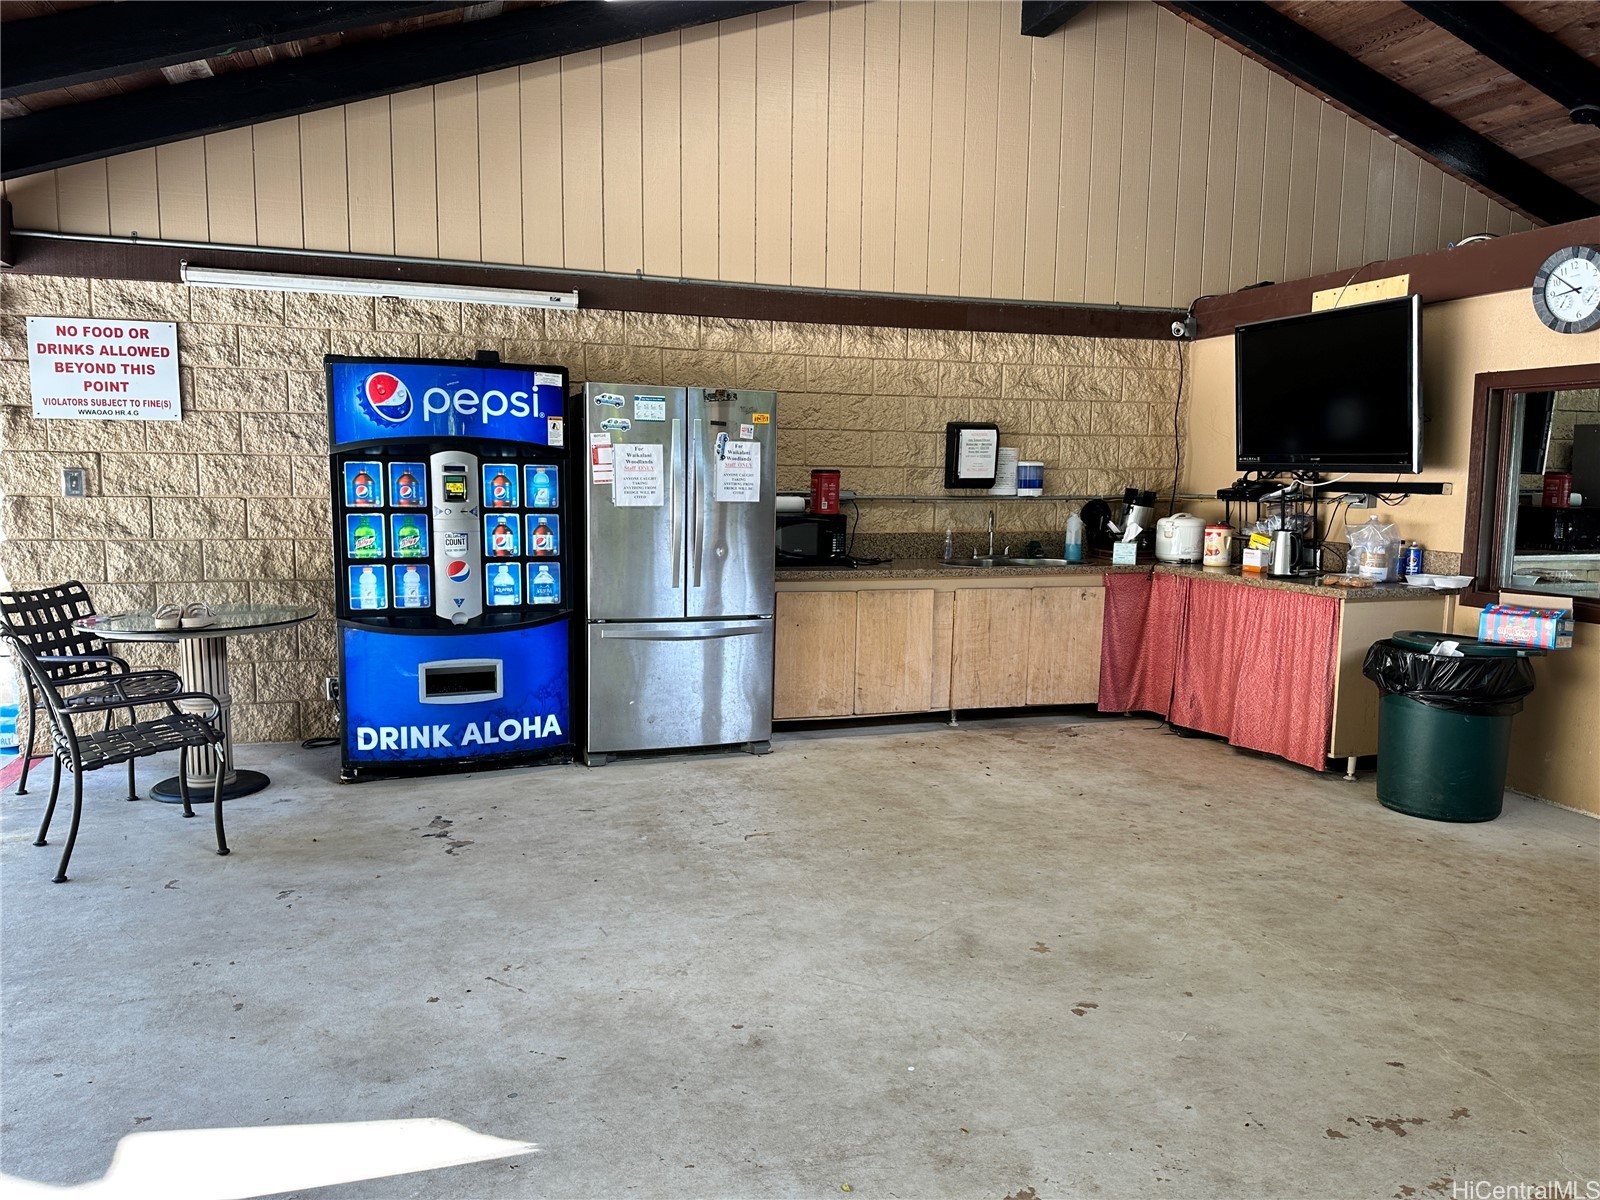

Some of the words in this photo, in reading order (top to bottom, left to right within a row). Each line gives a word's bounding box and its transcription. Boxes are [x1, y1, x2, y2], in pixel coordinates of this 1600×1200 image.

[1560, 267, 1568, 276] 11
[1570, 260, 1579, 270] 12
[56, 325, 78, 337] NO
[82, 326, 124, 339] FOOD
[128, 328, 150, 339] OR
[36, 343, 95, 355] DRINKS
[99, 345, 170, 358] ALLOWED
[54, 362, 116, 374] BEYOND
[120, 363, 156, 376] THIS
[83, 380, 129, 392] POINT
[42, 397, 89, 406] VIOLATORS
[91, 398, 127, 407] SUBJECT
[130, 399, 141, 407] TO
[142, 399, 172, 410] FINE(S)
[423, 385, 539, 424] pepsi
[445, 538, 465, 546] COUNT
[357, 724, 453, 751] DRINK
[460, 714, 563, 746] ALOHA
